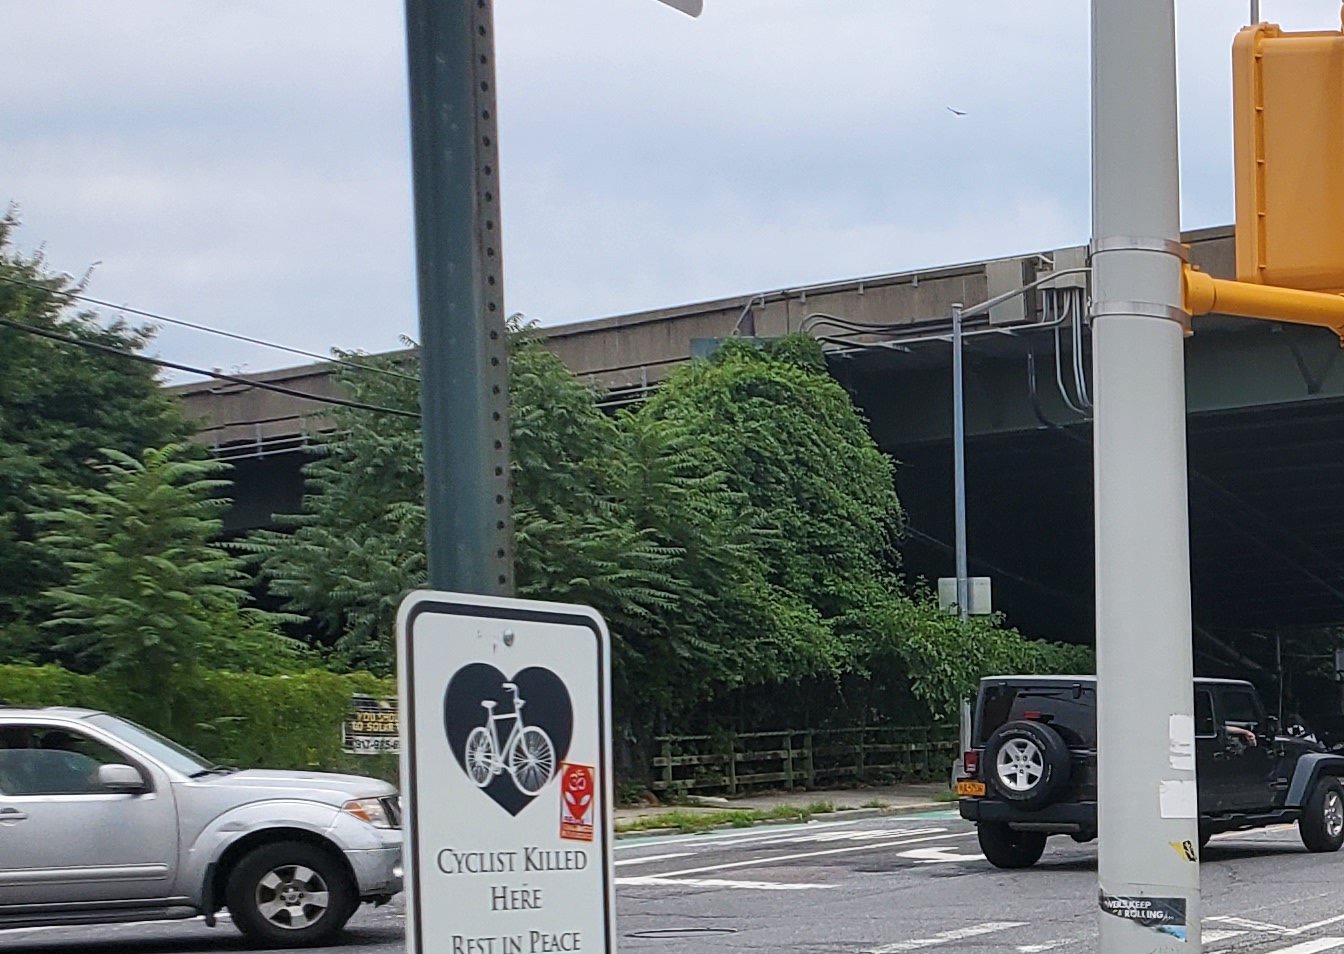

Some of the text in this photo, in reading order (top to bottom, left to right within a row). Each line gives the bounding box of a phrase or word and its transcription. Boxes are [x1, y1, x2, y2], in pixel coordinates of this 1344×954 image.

[437, 847, 588, 874] CYCLIST KILLED
[491, 886, 542, 911] HERE
[529, 930, 581, 954] PEACE
